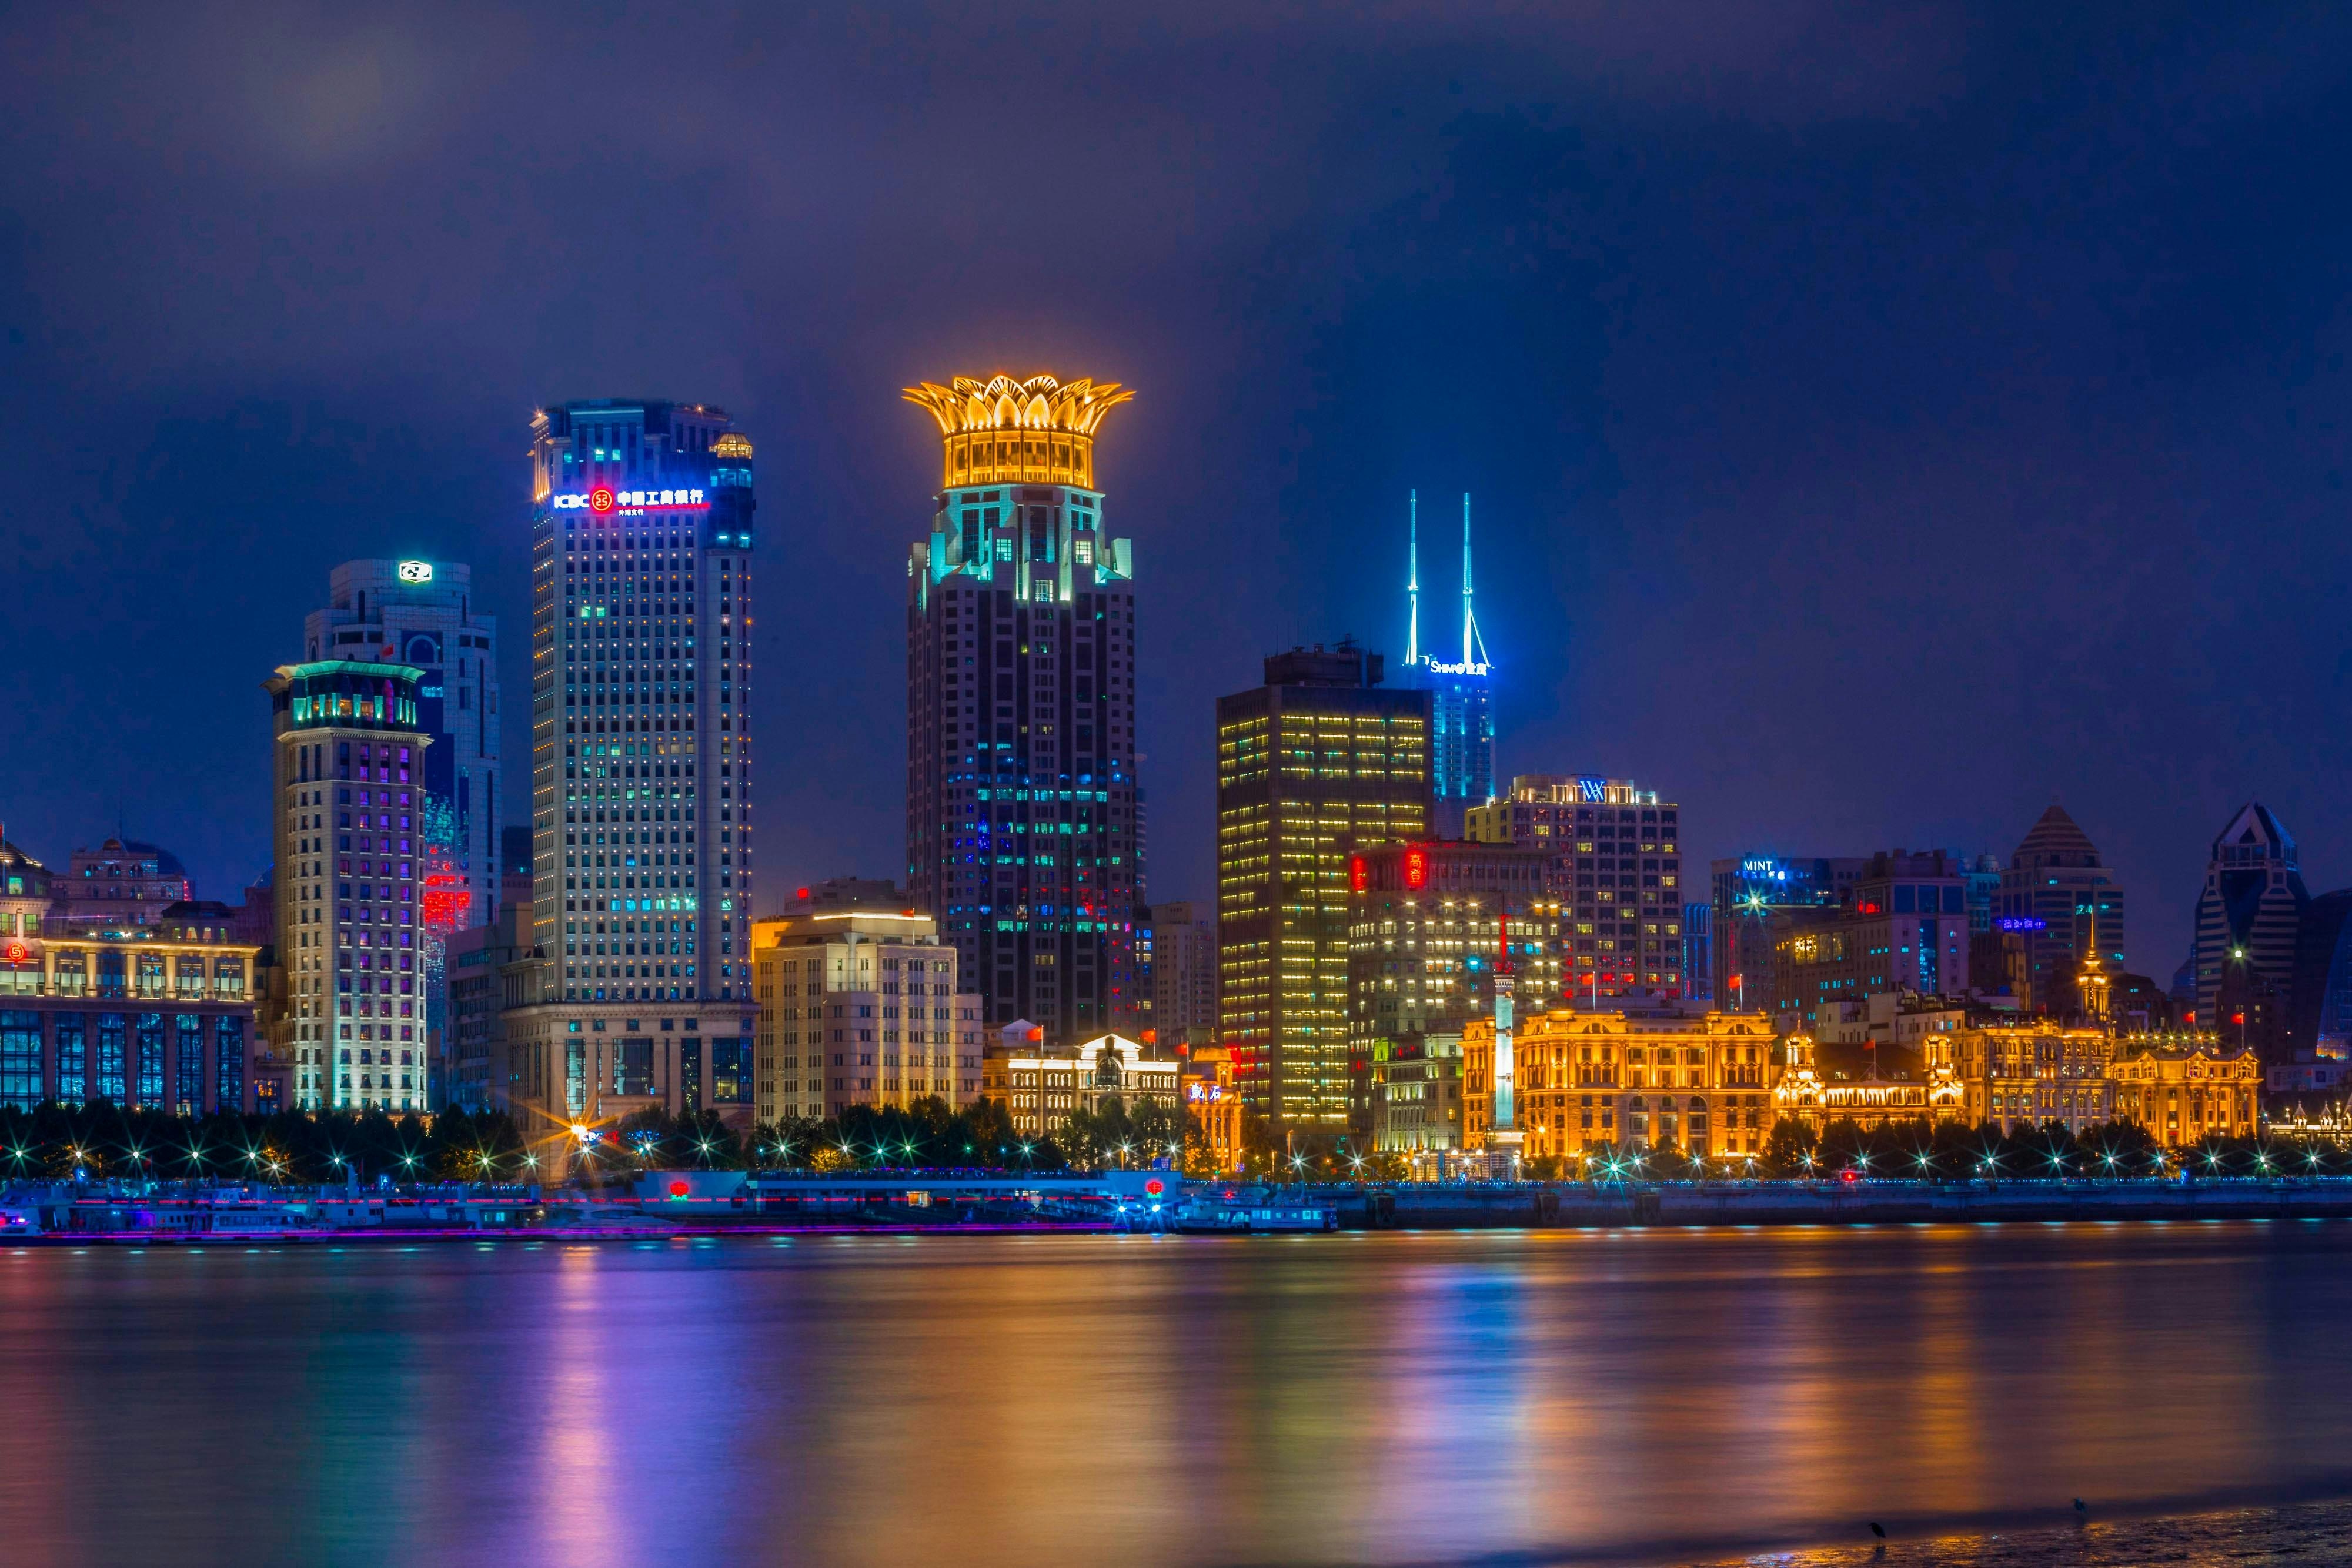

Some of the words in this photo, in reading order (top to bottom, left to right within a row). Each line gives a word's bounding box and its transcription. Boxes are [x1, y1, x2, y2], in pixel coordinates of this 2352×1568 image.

[554, 494, 589, 508] ICBC
[617, 489, 703, 506] 中国工商银行
[1745, 861, 1772, 871] MINT
